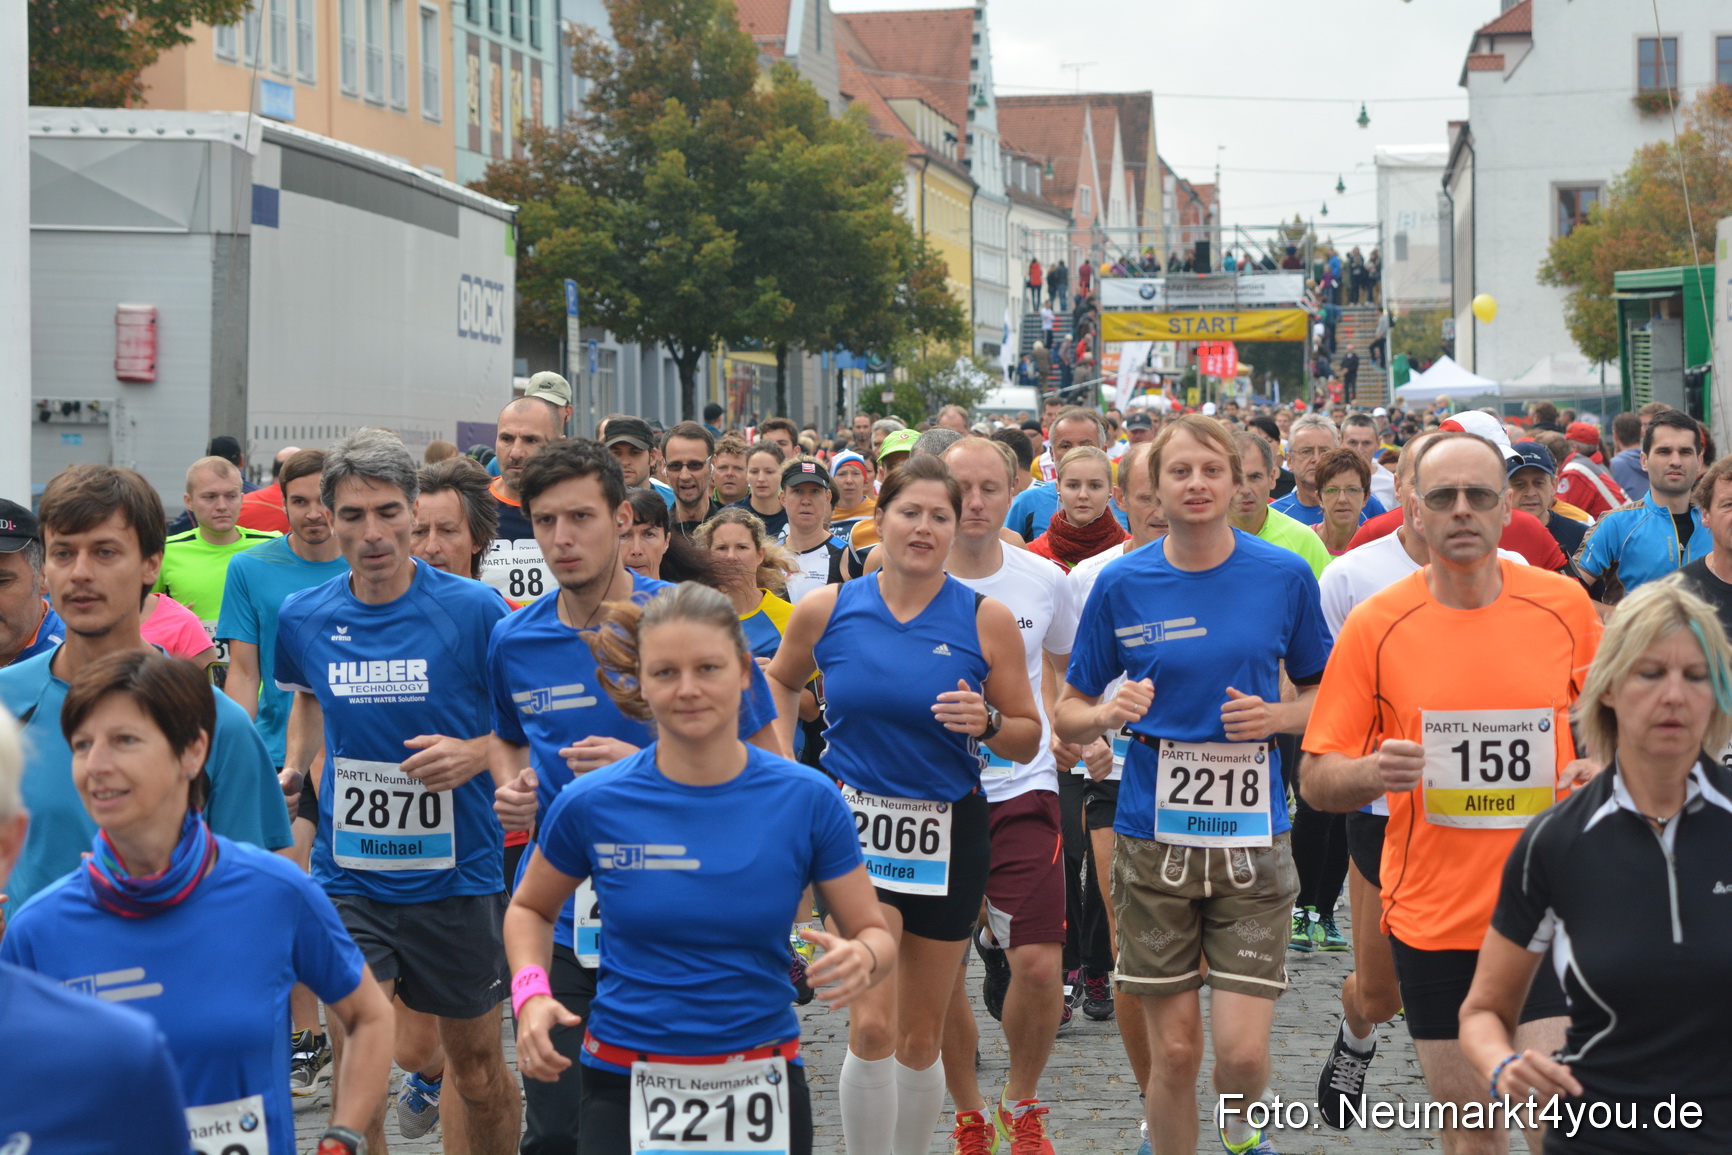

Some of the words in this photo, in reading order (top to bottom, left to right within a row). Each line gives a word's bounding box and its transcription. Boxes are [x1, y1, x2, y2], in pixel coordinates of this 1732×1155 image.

[458, 273, 504, 345] BOCK
[1169, 317, 1239, 334] START
[509, 567, 544, 598] 88
[330, 634, 352, 642] erima
[932, 649, 952, 657] adidas
[328, 658, 429, 684] HUBER
[349, 683, 424, 694] TECHNOLOGY
[349, 696, 373, 704] WASTE
[373, 696, 397, 704] WATER
[397, 695, 426, 703] Solutions
[1425, 722, 1469, 733] PARTL
[1472, 721, 1534, 733] Neumarkt
[1161, 749, 1199, 762] PARTL
[1201, 752, 1251, 763] Neumarkt
[1451, 739, 1531, 783] 158
[337, 768, 372, 782] PARTL
[1168, 766, 1259, 807] 2218
[345, 787, 441, 829] 2870
[843, 794, 878, 807] PARTL
[880, 799, 932, 812] Neumarkt
[1465, 795, 1515, 811] Alfred
[853, 811, 940, 855] 2066
[1187, 816, 1238, 836] Philipp
[360, 838, 423, 855] Michael
[865, 860, 915, 879] Andrea
[636, 1074, 686, 1090] PARTL
[690, 1073, 761, 1091] Neumarkt
[649, 1092, 773, 1143] 2219
